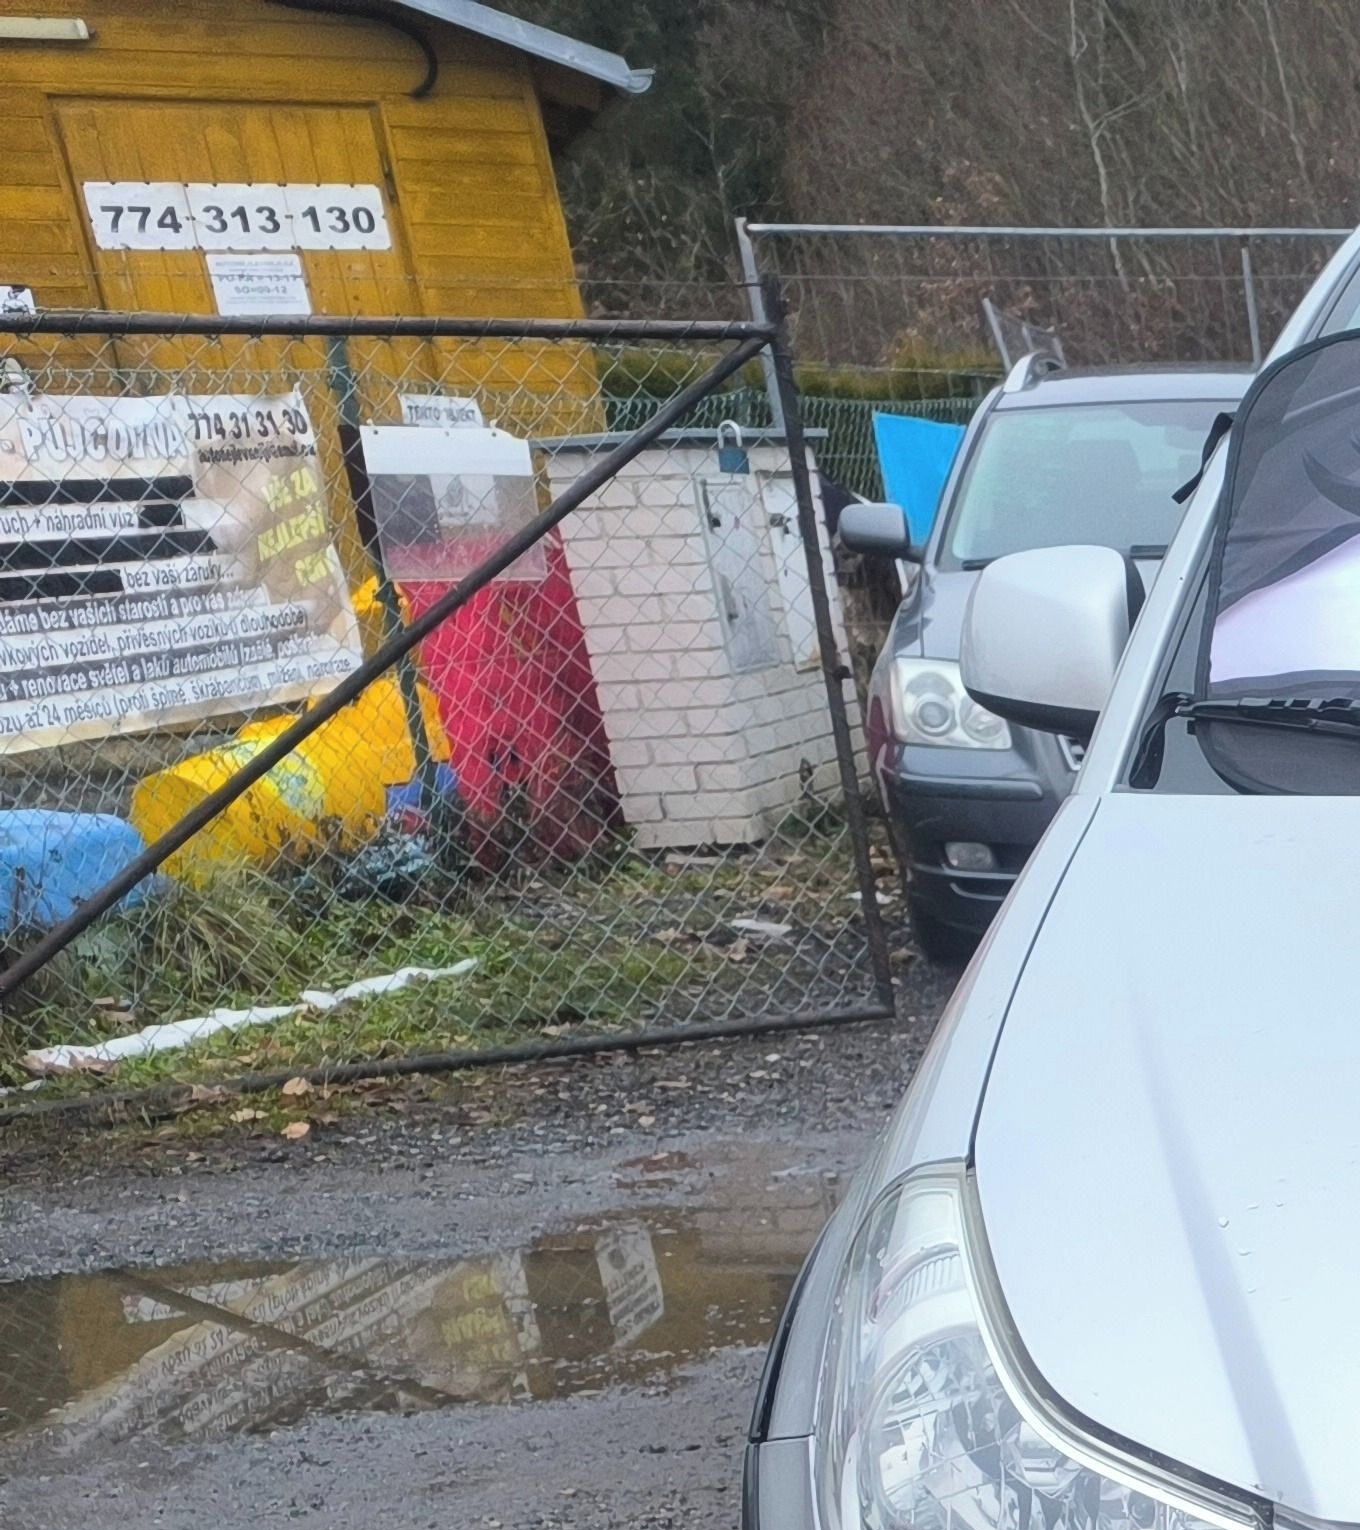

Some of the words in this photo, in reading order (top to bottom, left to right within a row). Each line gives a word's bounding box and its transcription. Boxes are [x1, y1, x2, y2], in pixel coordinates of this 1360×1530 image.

[188, 412, 226, 440] 774
[229, 411, 250, 439] 31
[255, 410, 281, 437] 31
[282, 408, 308, 435] 30
[37, 606, 70, 630] bez
[131, 664, 142, 681] a
